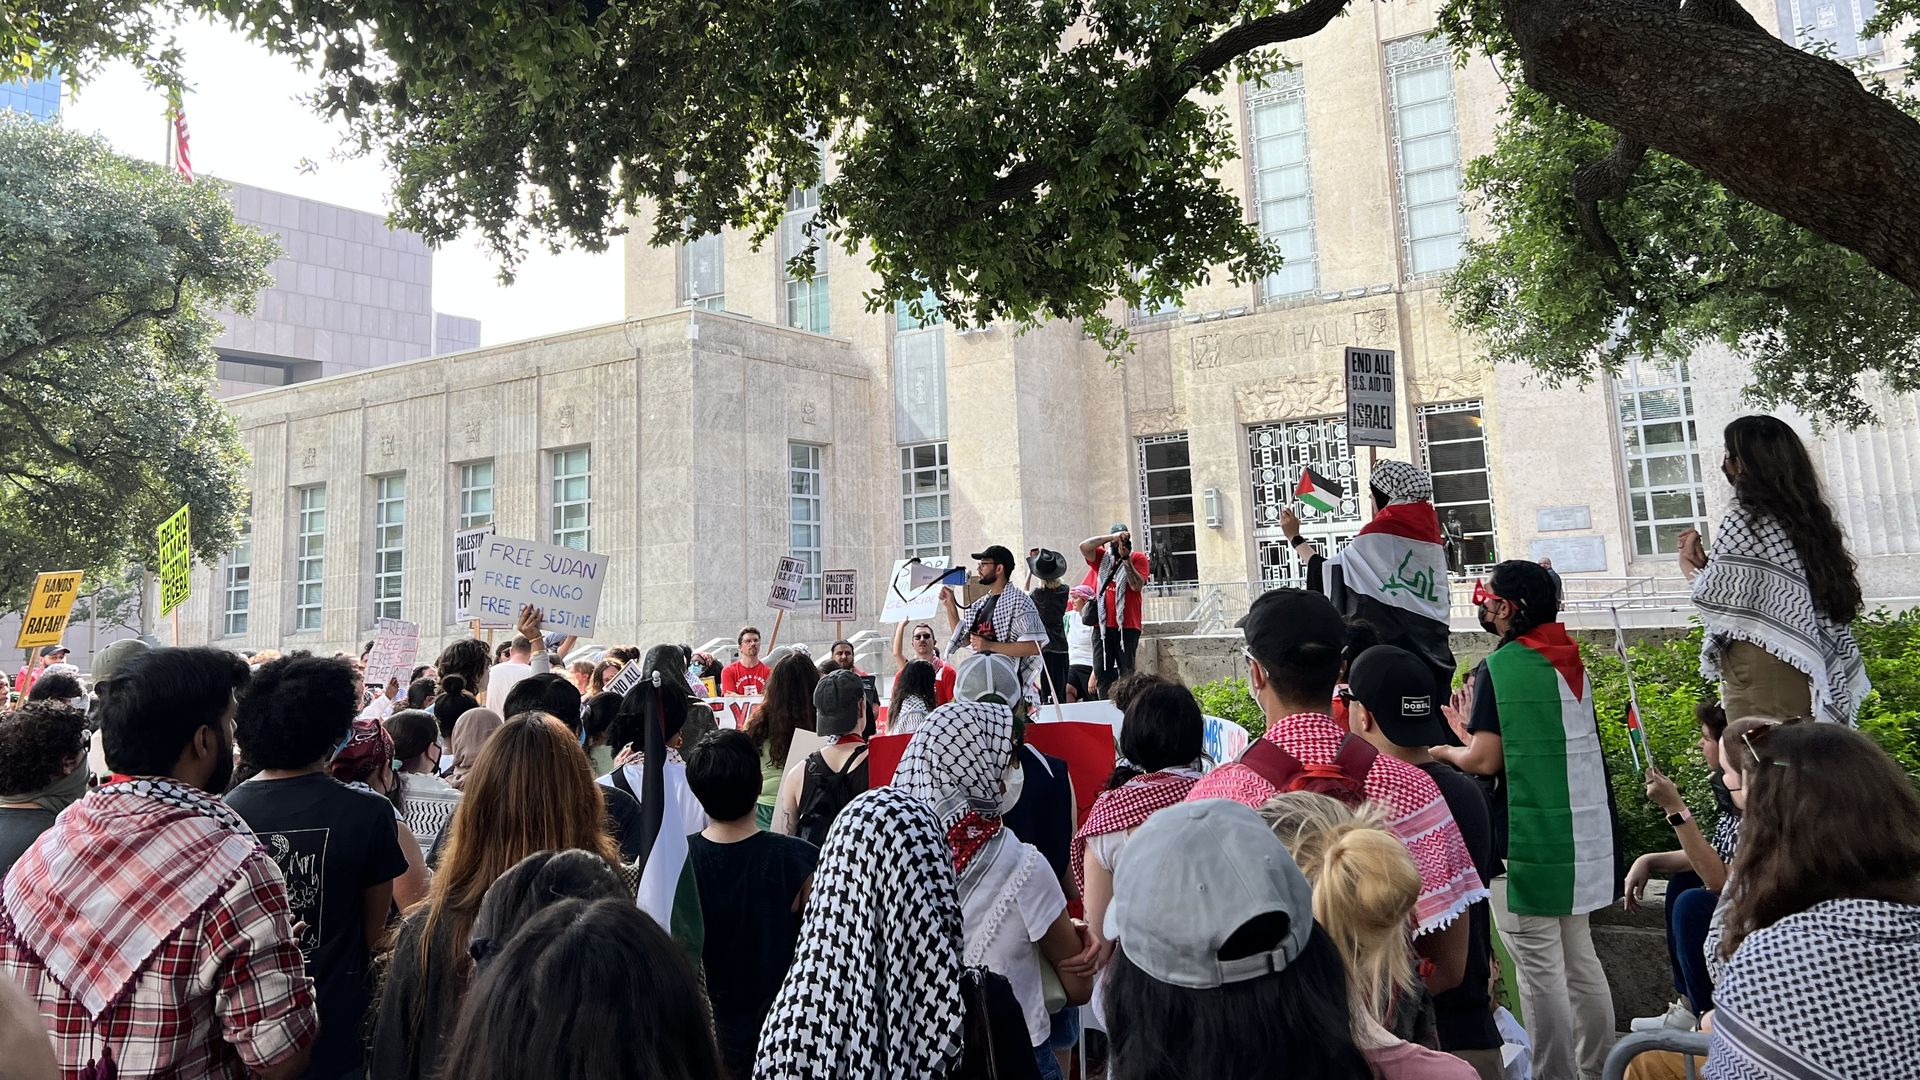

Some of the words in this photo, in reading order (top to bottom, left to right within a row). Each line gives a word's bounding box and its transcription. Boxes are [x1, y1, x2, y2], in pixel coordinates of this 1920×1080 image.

[1231, 329, 1280, 358] CITY
[1293, 321, 1347, 351] HALL
[1352, 352, 1372, 374] END
[1374, 353, 1391, 376] ALL
[1352, 375, 1367, 391] U.S.
[1368, 376, 1381, 392] AID
[1382, 377, 1392, 393] TO
[1352, 402, 1393, 430] ISRAEL
[161, 521, 174, 549] DEL
[175, 510, 187, 535] RIO
[170, 531, 187, 557] MAR
[456, 532, 490, 553] PALESTI
[456, 550, 476, 573] WILL
[489, 543, 535, 568] FREE
[539, 553, 598, 581] SUDAN
[780, 560, 795, 572] END
[793, 562, 805, 575] ALL
[43, 577, 75, 594] HANDS
[484, 571, 522, 590] FREE
[530, 579, 583, 601] CONGO
[825, 574, 854, 583] PALESTINE
[457, 577, 474, 610] FR
[772, 585, 797, 603] ISRAEL
[825, 584, 843, 596] WILL
[844, 584, 854, 595] BE
[45, 594, 62, 609] OFF
[825, 597, 854, 614] FREE!
[480, 596, 512, 616] FREE
[517, 602, 591, 629] PLESTINE
[25, 615, 66, 635] RAFAH!
[380, 619, 408, 637] FREE
[376, 637, 401, 651] FREE
[610, 679, 629, 695] ND
[624, 667, 641, 686] ALL
